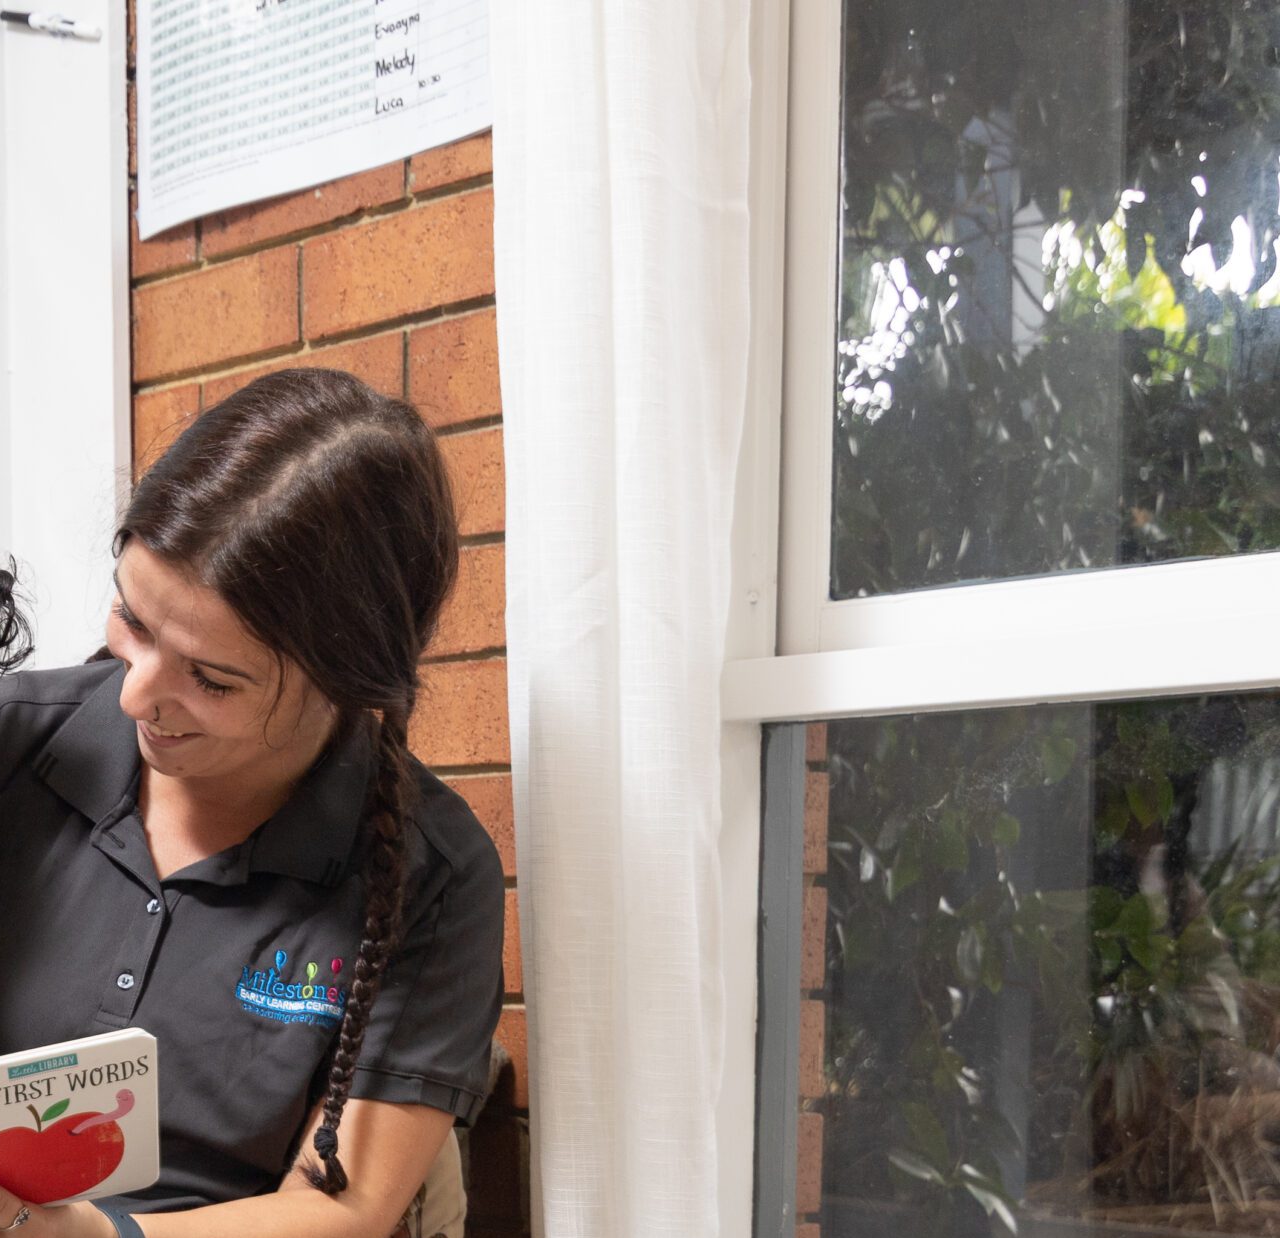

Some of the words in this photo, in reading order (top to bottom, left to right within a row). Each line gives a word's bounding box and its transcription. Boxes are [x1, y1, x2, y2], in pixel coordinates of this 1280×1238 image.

[376, 48, 415, 77] Melody
[375, 97, 404, 115] Luca
[238, 965, 345, 1004] Milestones
[38, 1055, 76, 1072] LIBRARY
[65, 1055, 150, 1092] WORDS
